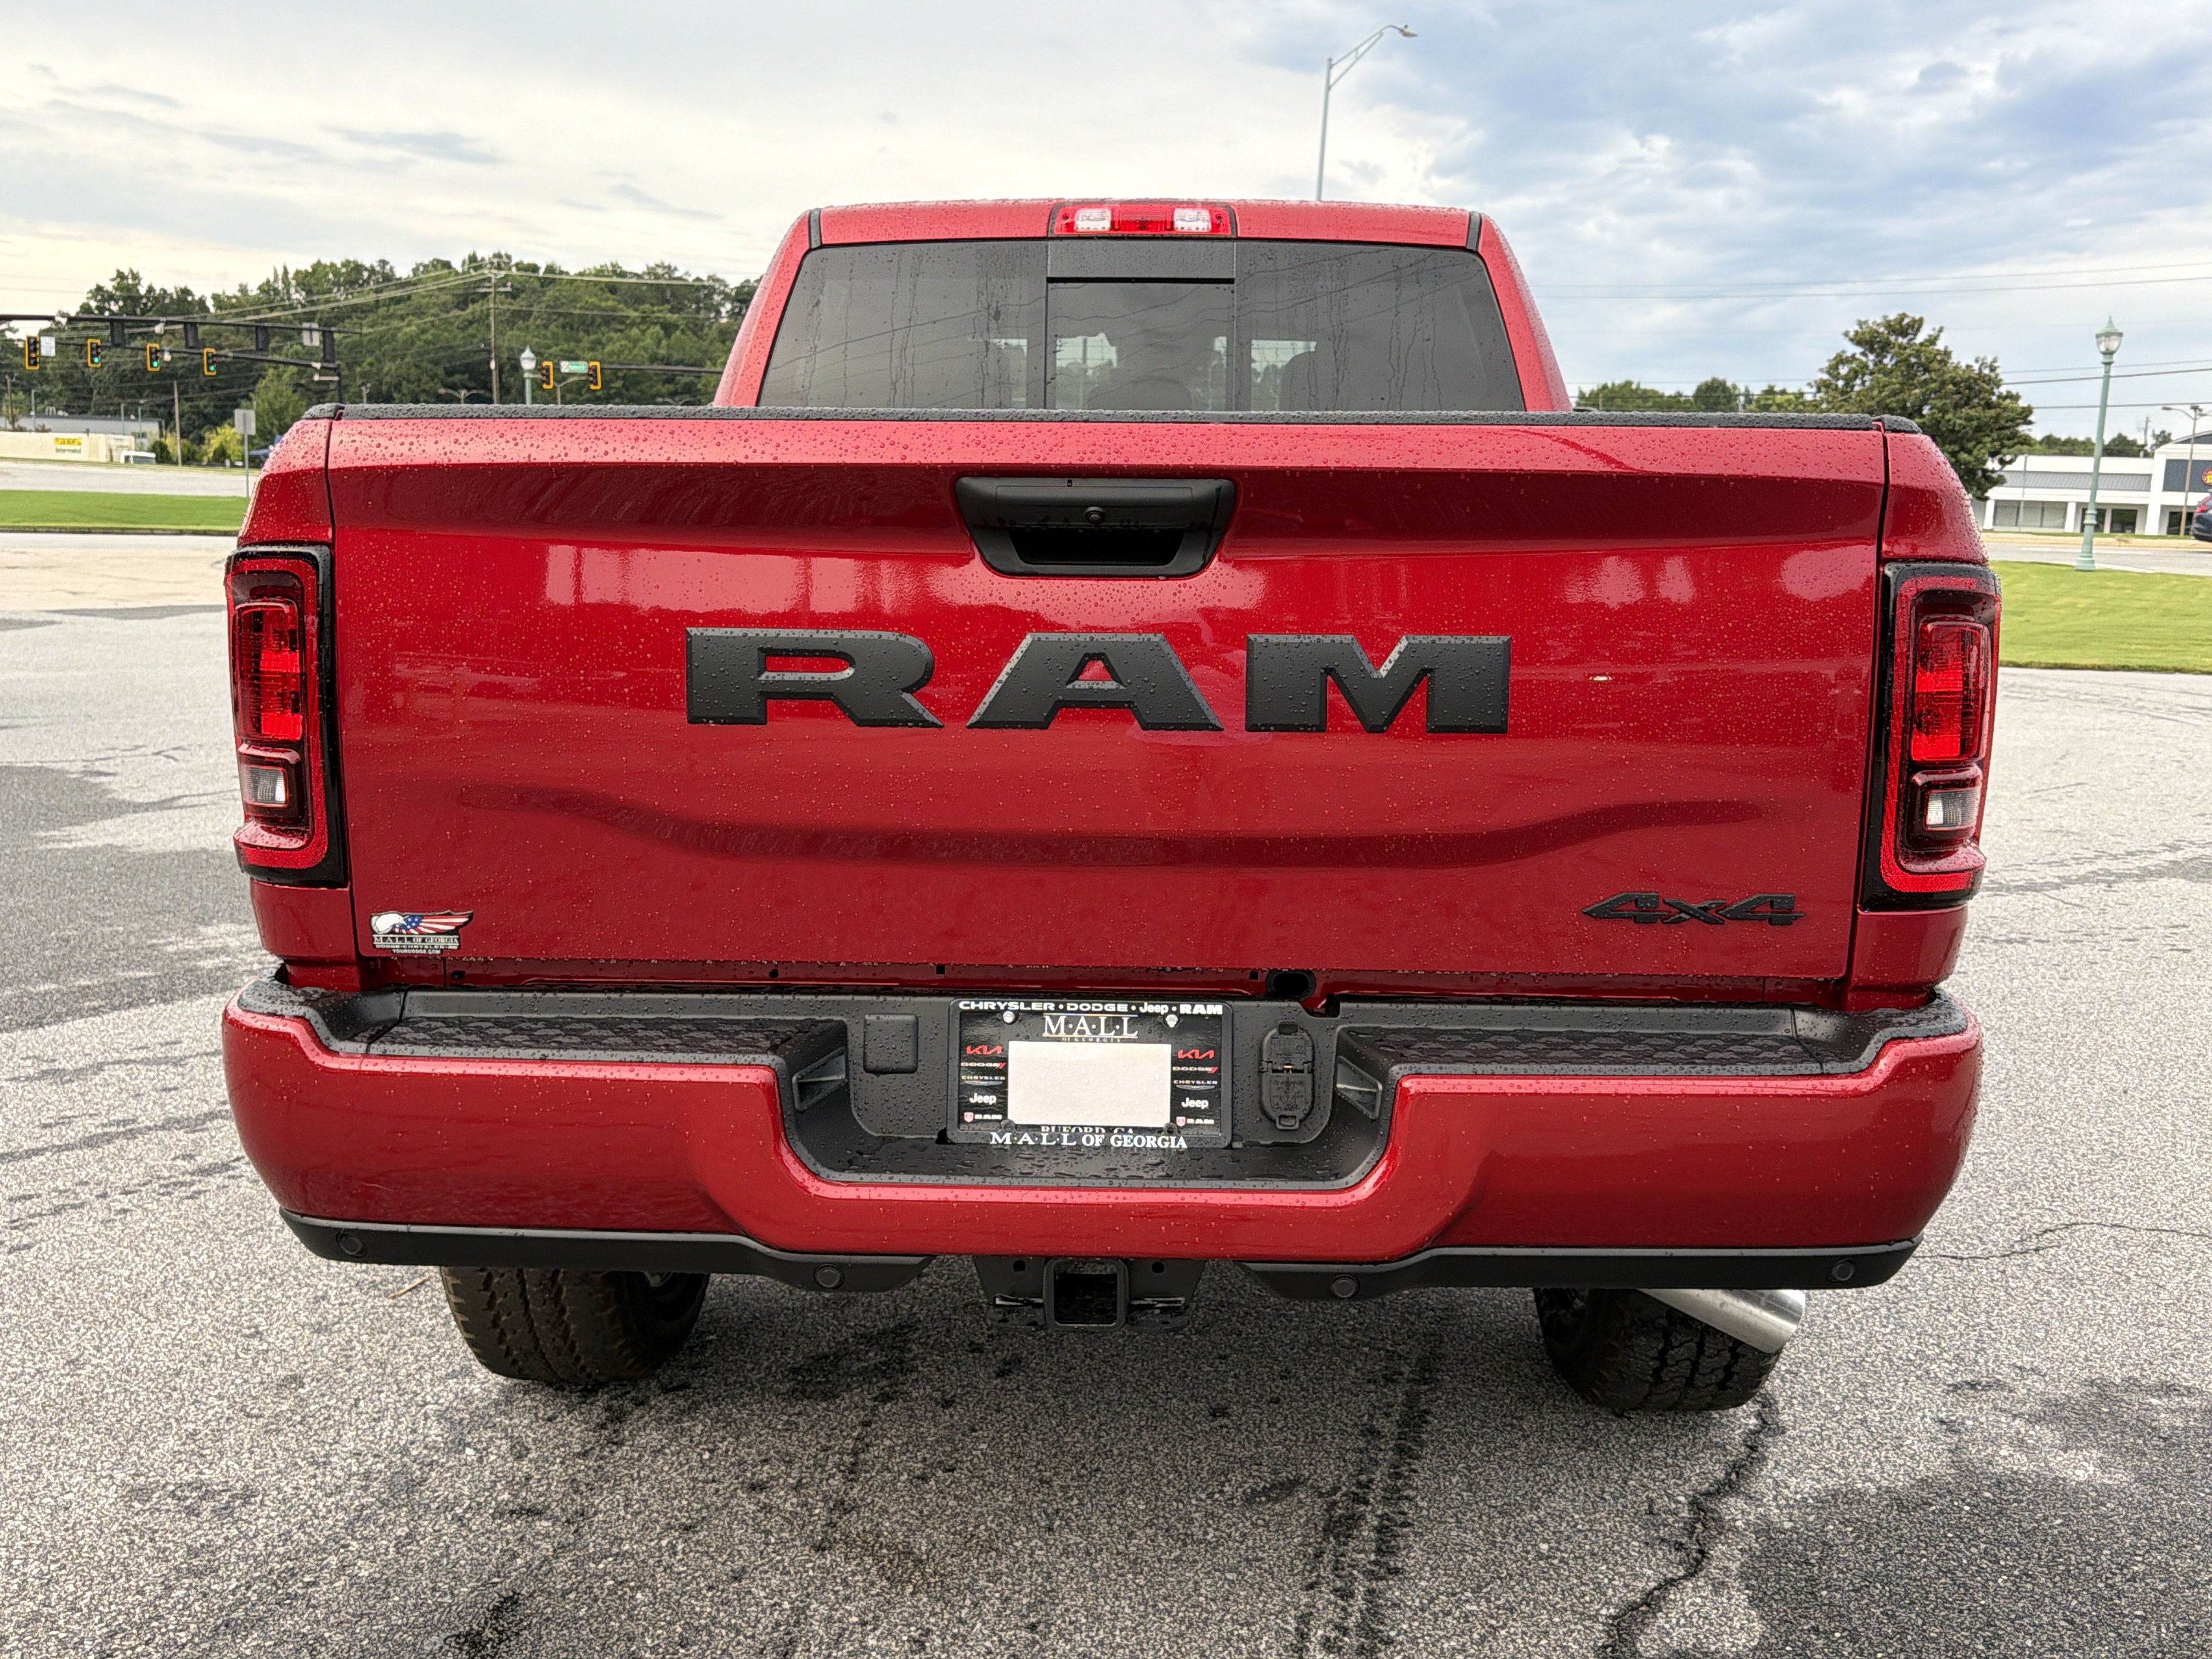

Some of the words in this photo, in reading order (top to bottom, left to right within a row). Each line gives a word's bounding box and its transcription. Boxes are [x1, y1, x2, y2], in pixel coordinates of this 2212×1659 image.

[685, 627, 1511, 733] RAM
[959, 1001, 1055, 1010] CHRYSLER
[1066, 1003, 1128, 1012] DODGE
[1139, 1002, 1169, 1014] Jeep
[1180, 1004, 1223, 1014] RAM
[966, 1045, 1003, 1054] KIA
[1177, 1049, 1214, 1059] KIA
[969, 1093, 997, 1105] Jeep
[1181, 1097, 1209, 1109] Jeep
[1081, 1134, 1105, 1147] OF
[1110, 1135, 1188, 1148] GEORGIA
